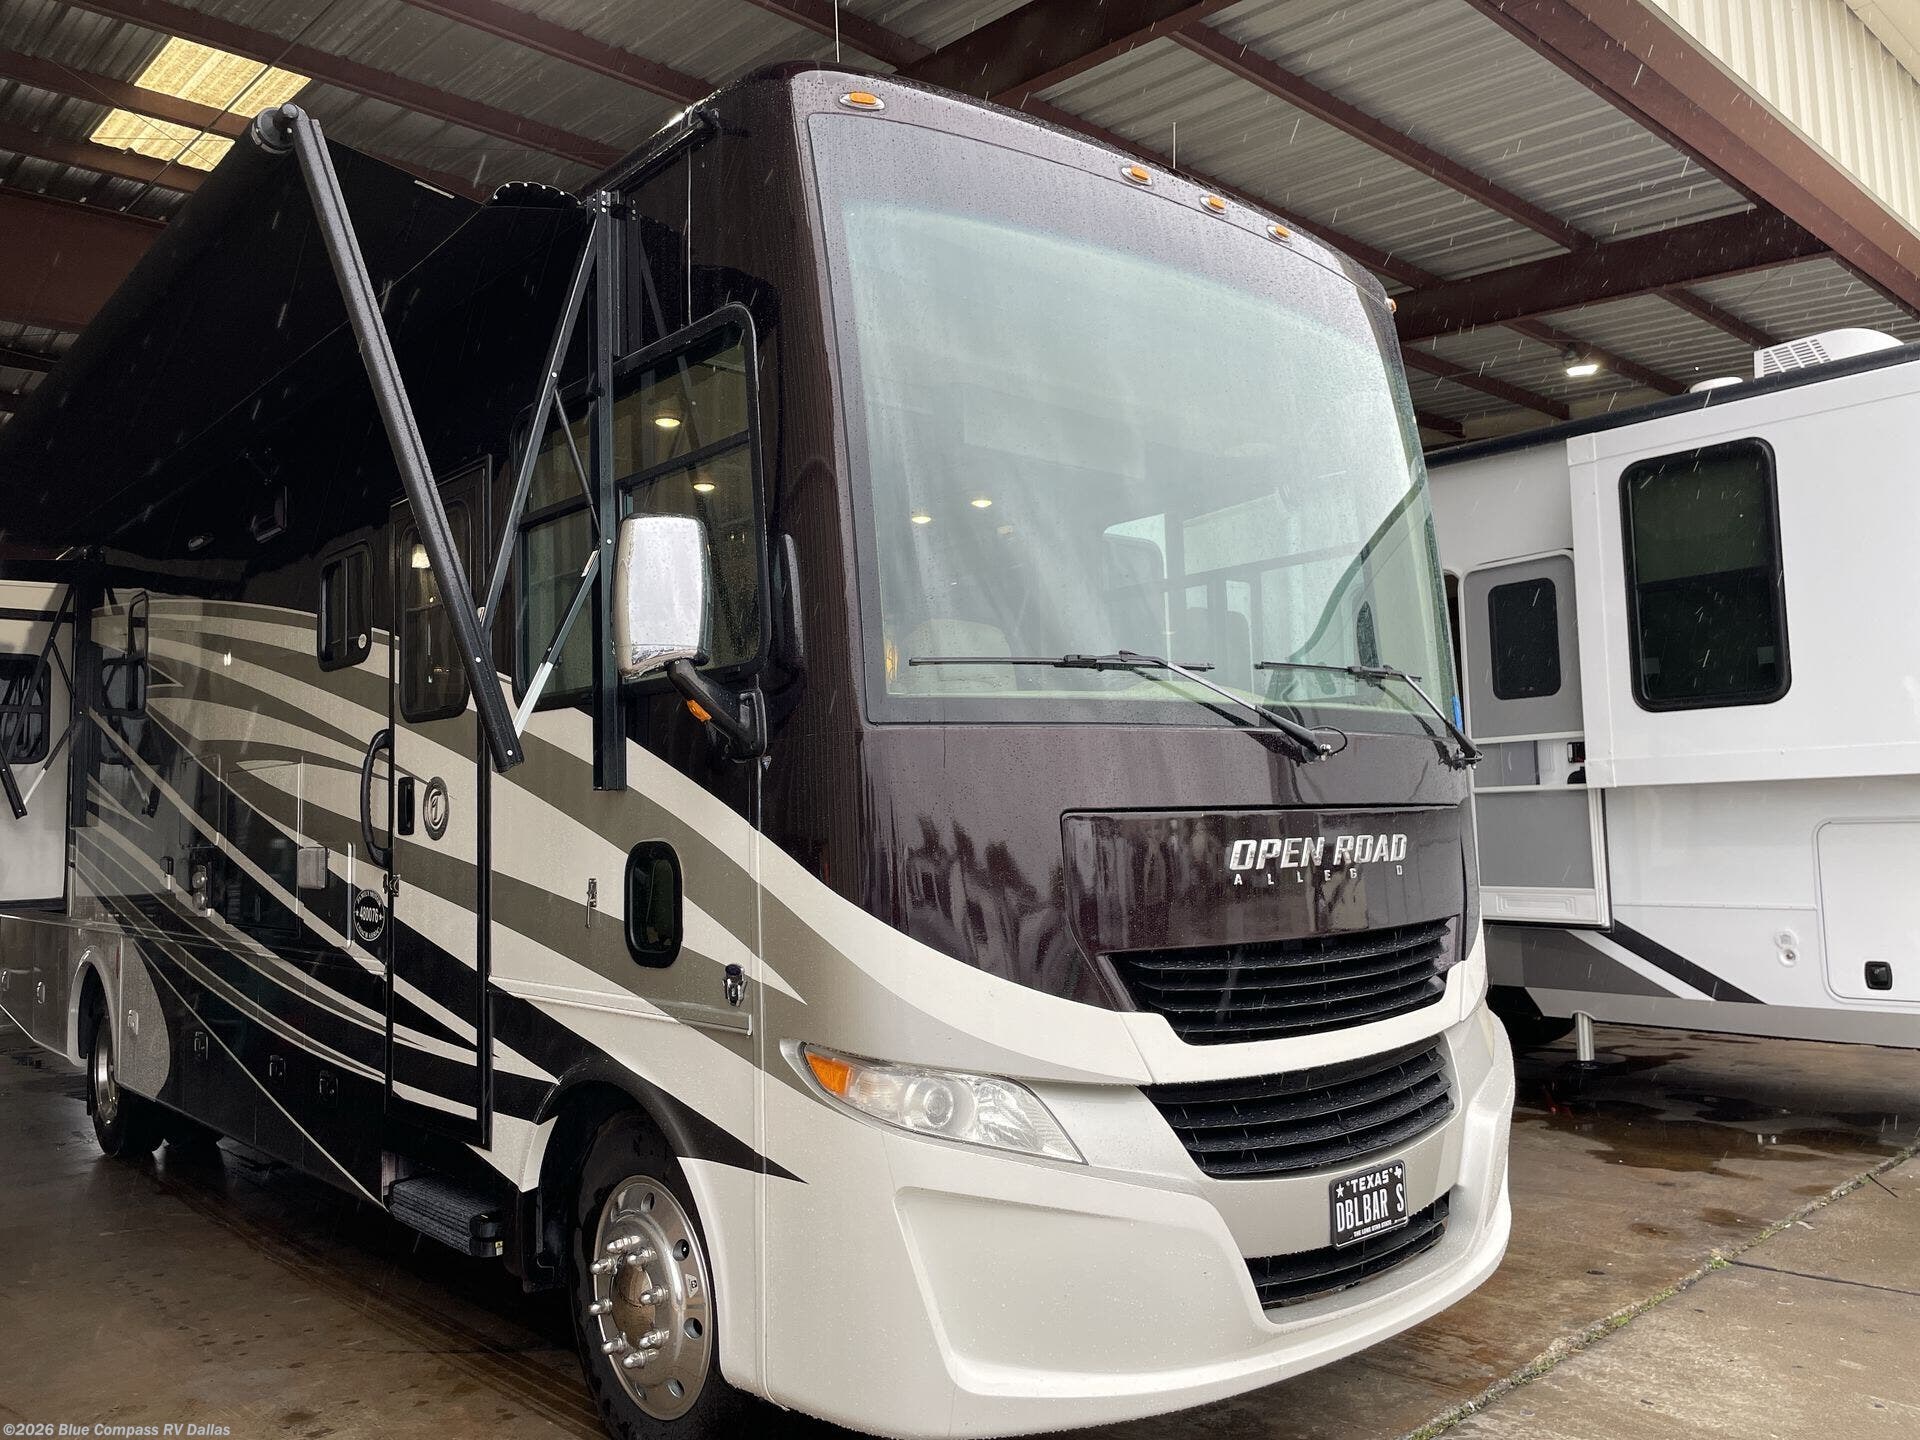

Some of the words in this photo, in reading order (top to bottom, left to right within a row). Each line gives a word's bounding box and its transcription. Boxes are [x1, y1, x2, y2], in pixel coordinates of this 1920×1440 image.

[1229, 837, 1325, 870] OPEN
[1333, 833, 1408, 866] ROAD
[1350, 1169, 1390, 1193] TEXAS
[1395, 1182, 1405, 1212] S
